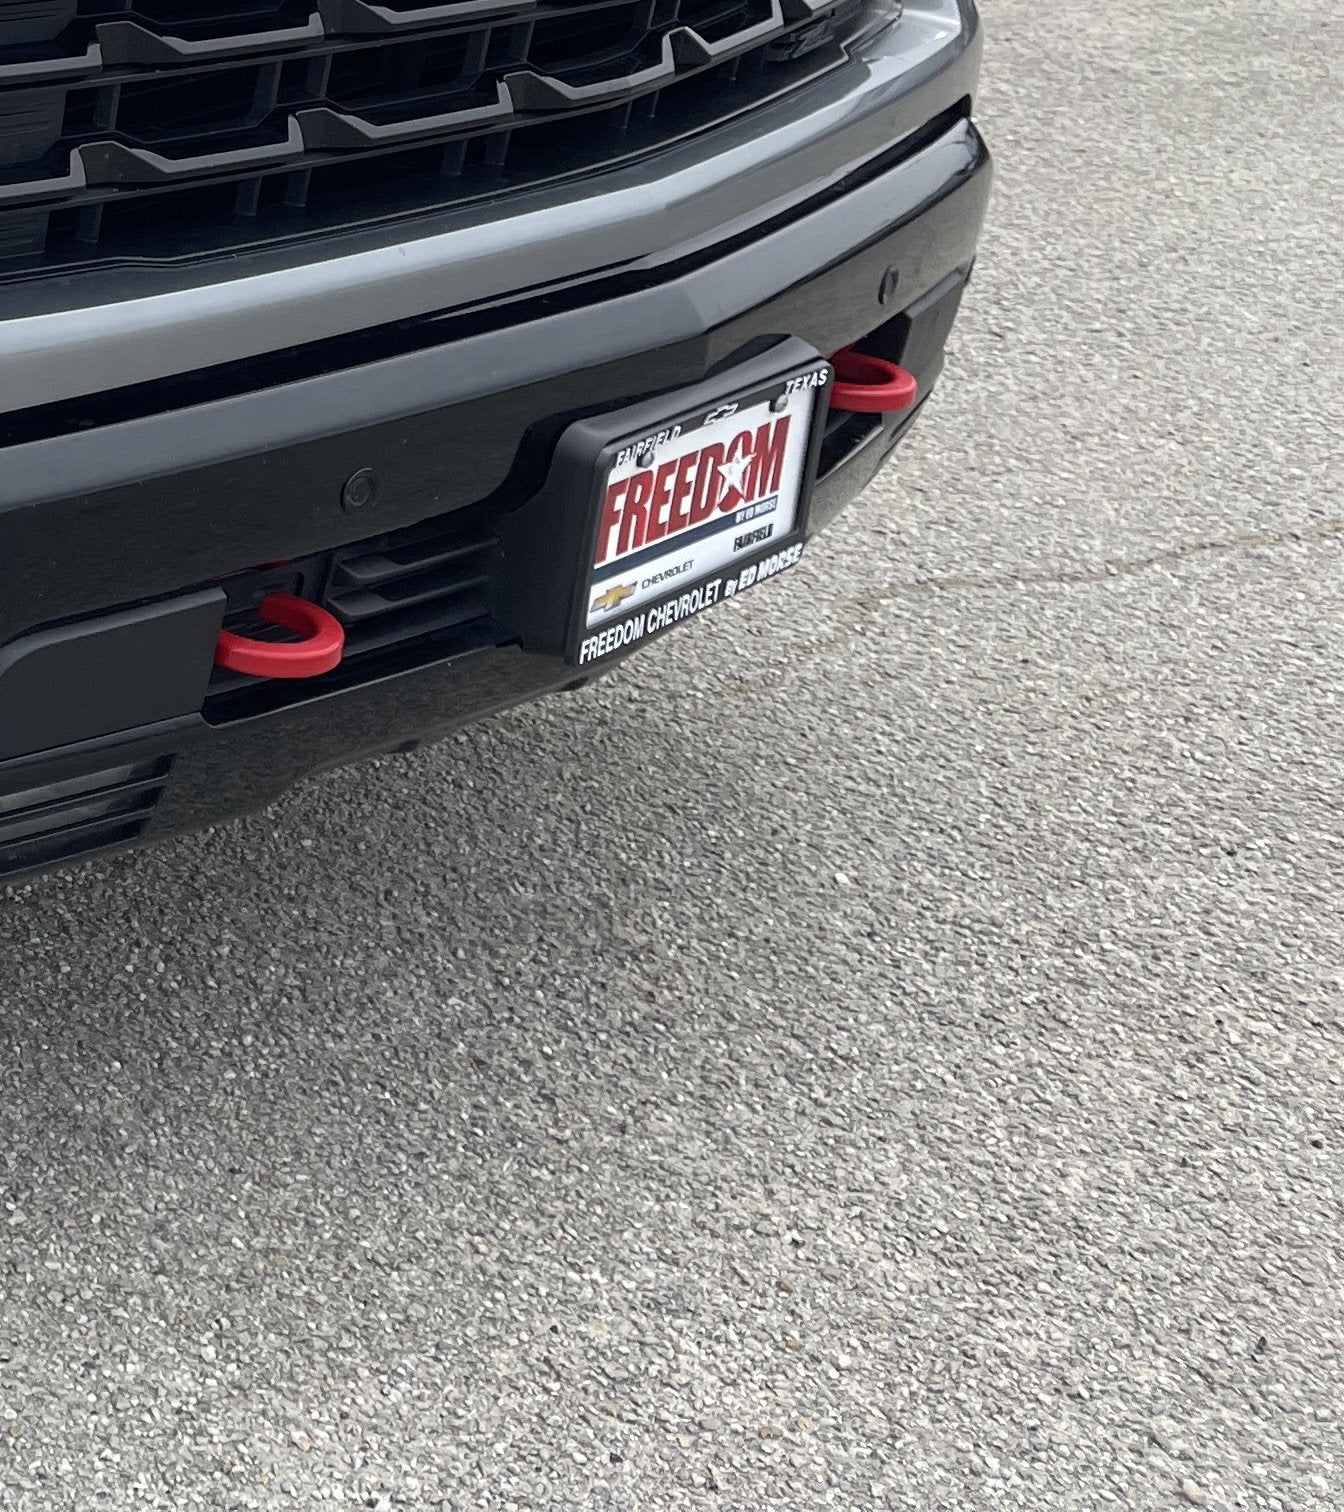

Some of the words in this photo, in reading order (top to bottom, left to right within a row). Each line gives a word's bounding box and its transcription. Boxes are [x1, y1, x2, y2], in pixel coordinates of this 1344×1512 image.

[783, 368, 829, 395] TEXAS
[615, 425, 682, 469] FAIRFIELD
[594, 414, 792, 565] FREEDOM
[641, 559, 695, 590] CHEVROLET
[579, 613, 645, 665] FREEDOM
[647, 578, 723, 634] CHEVROLET
[739, 565, 757, 590] ED
[757, 543, 803, 581] MORSE
